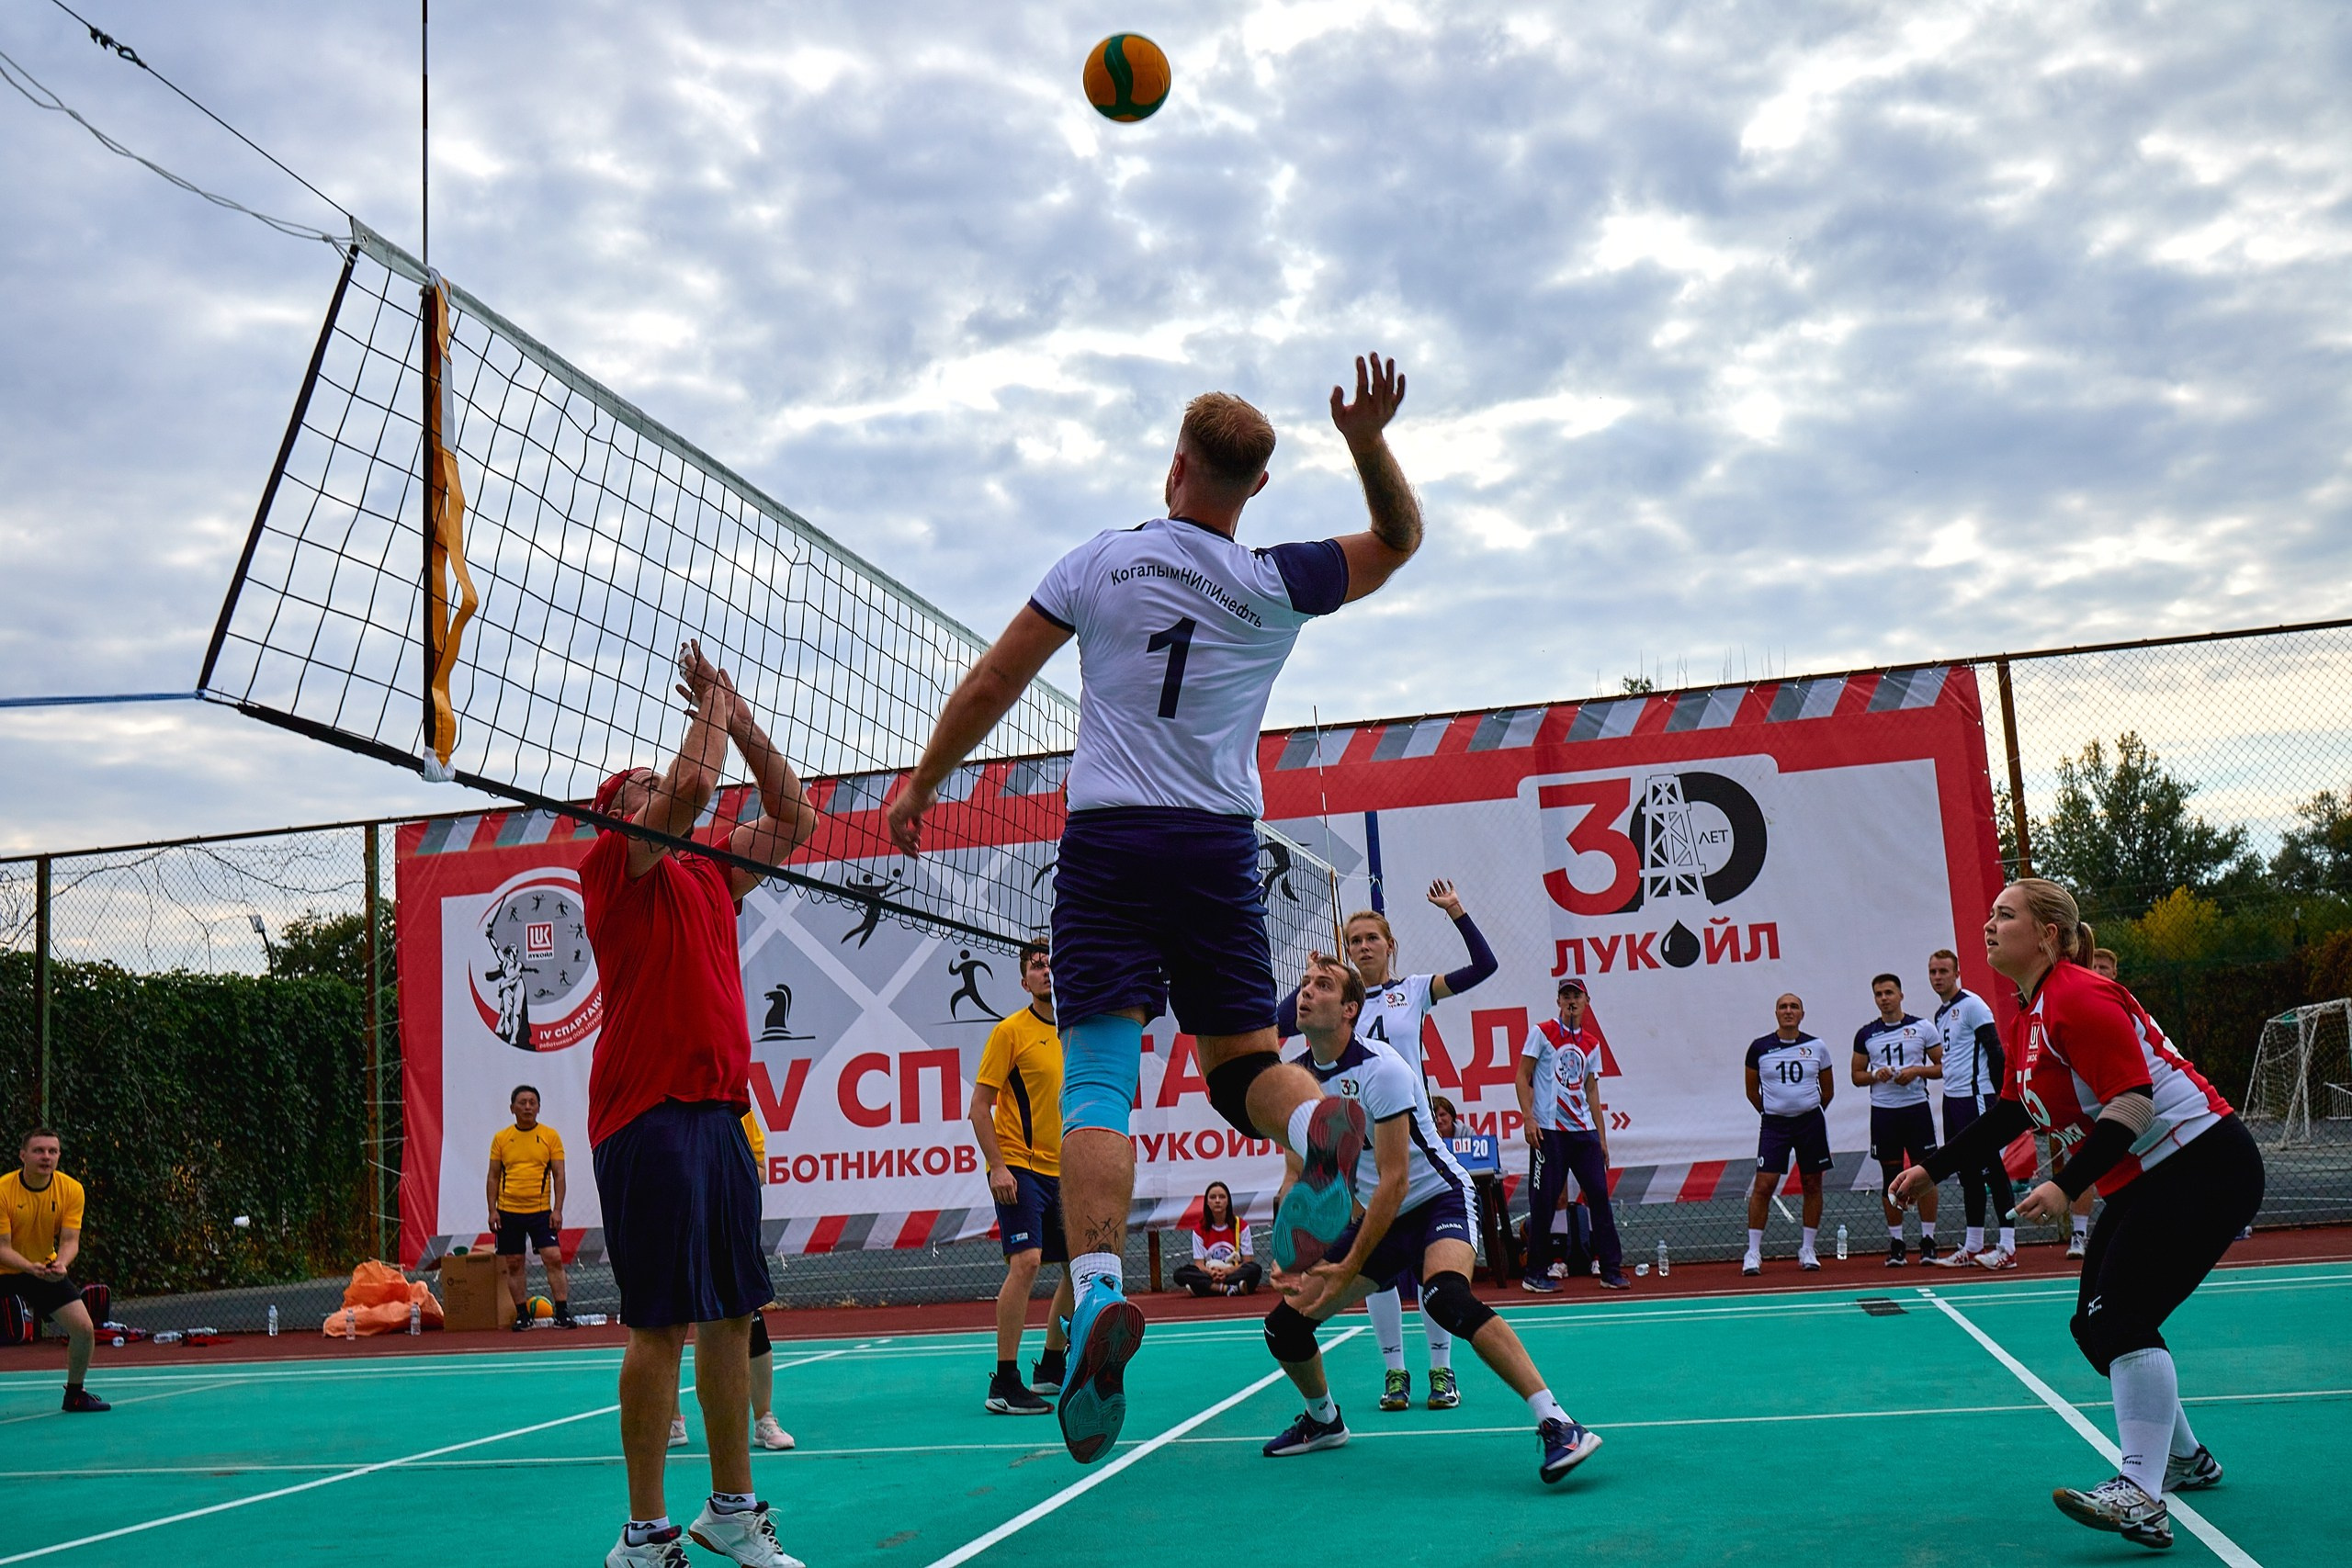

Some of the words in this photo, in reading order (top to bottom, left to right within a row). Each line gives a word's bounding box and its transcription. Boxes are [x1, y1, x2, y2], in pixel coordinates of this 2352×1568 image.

[1111, 564, 1263, 629] КогалымНИПИнефть
[1146, 616, 1197, 720] 1
[1538, 772, 1768, 916] 30
[1699, 829, 1729, 845] ЛЕТ
[539, 1030, 552, 1041] IV
[554, 990, 603, 1038] СПАРТАКИ
[1366, 1014, 1390, 1044] 4
[1943, 1028, 1951, 1053] 5
[1881, 1043, 1904, 1066] 11
[1775, 1060, 1804, 1084] 10
[1472, 1138, 1488, 1157] 20
[763, 1145, 978, 1185] БОТНИКОВ
[712, 1492, 747, 1504] FILA
